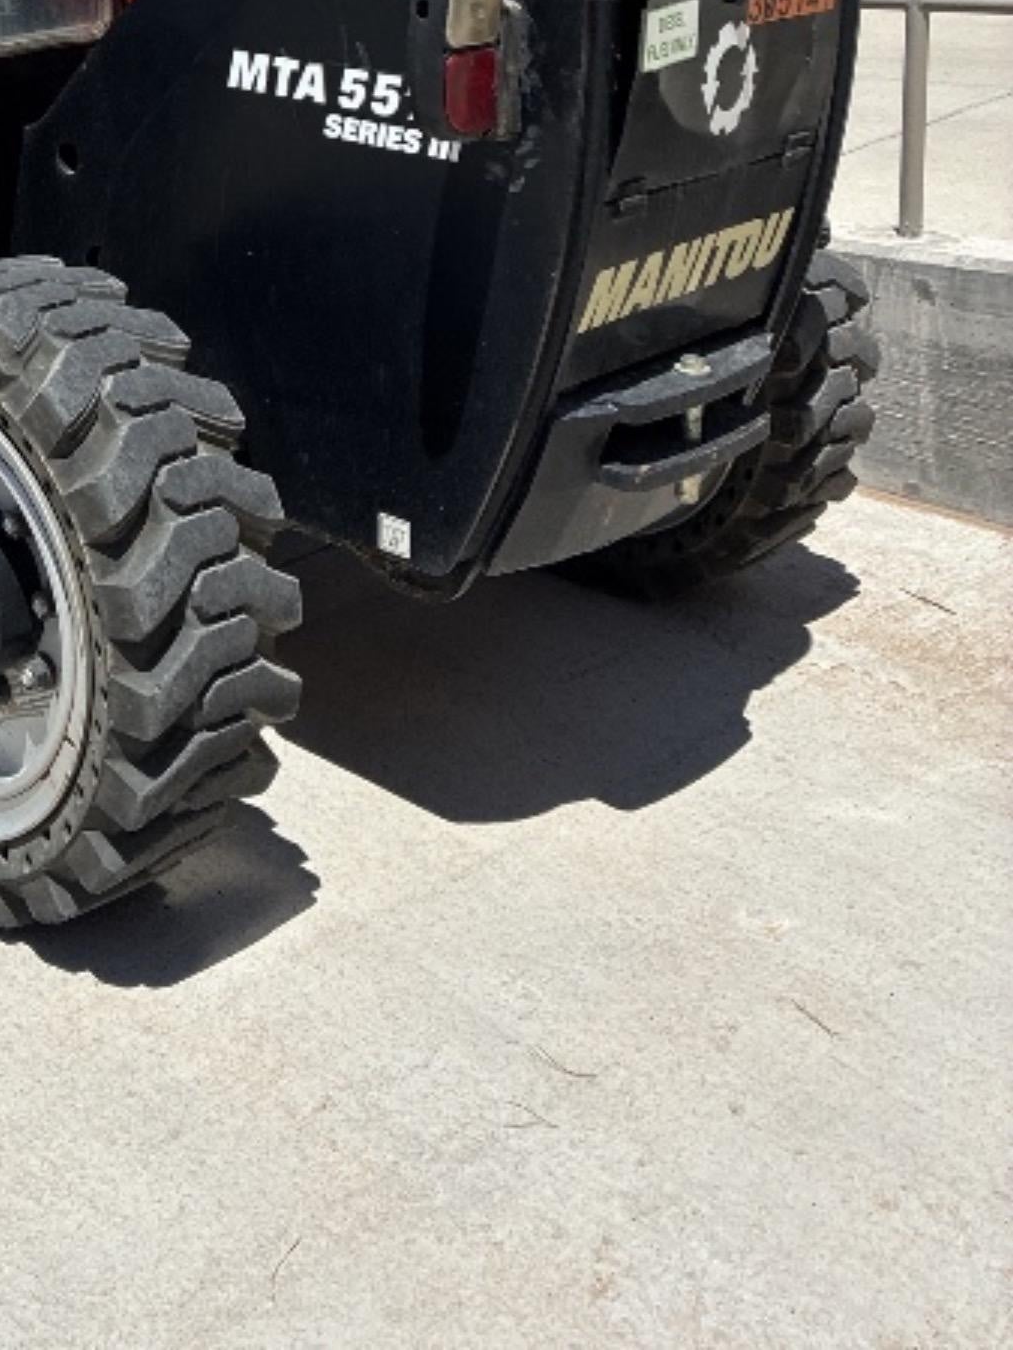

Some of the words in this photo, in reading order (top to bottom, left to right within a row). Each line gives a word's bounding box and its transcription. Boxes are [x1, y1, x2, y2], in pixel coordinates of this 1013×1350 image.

[227, 50, 326, 105] MTA
[322, 113, 424, 154] SERIES
[577, 207, 795, 335] MANITOU
